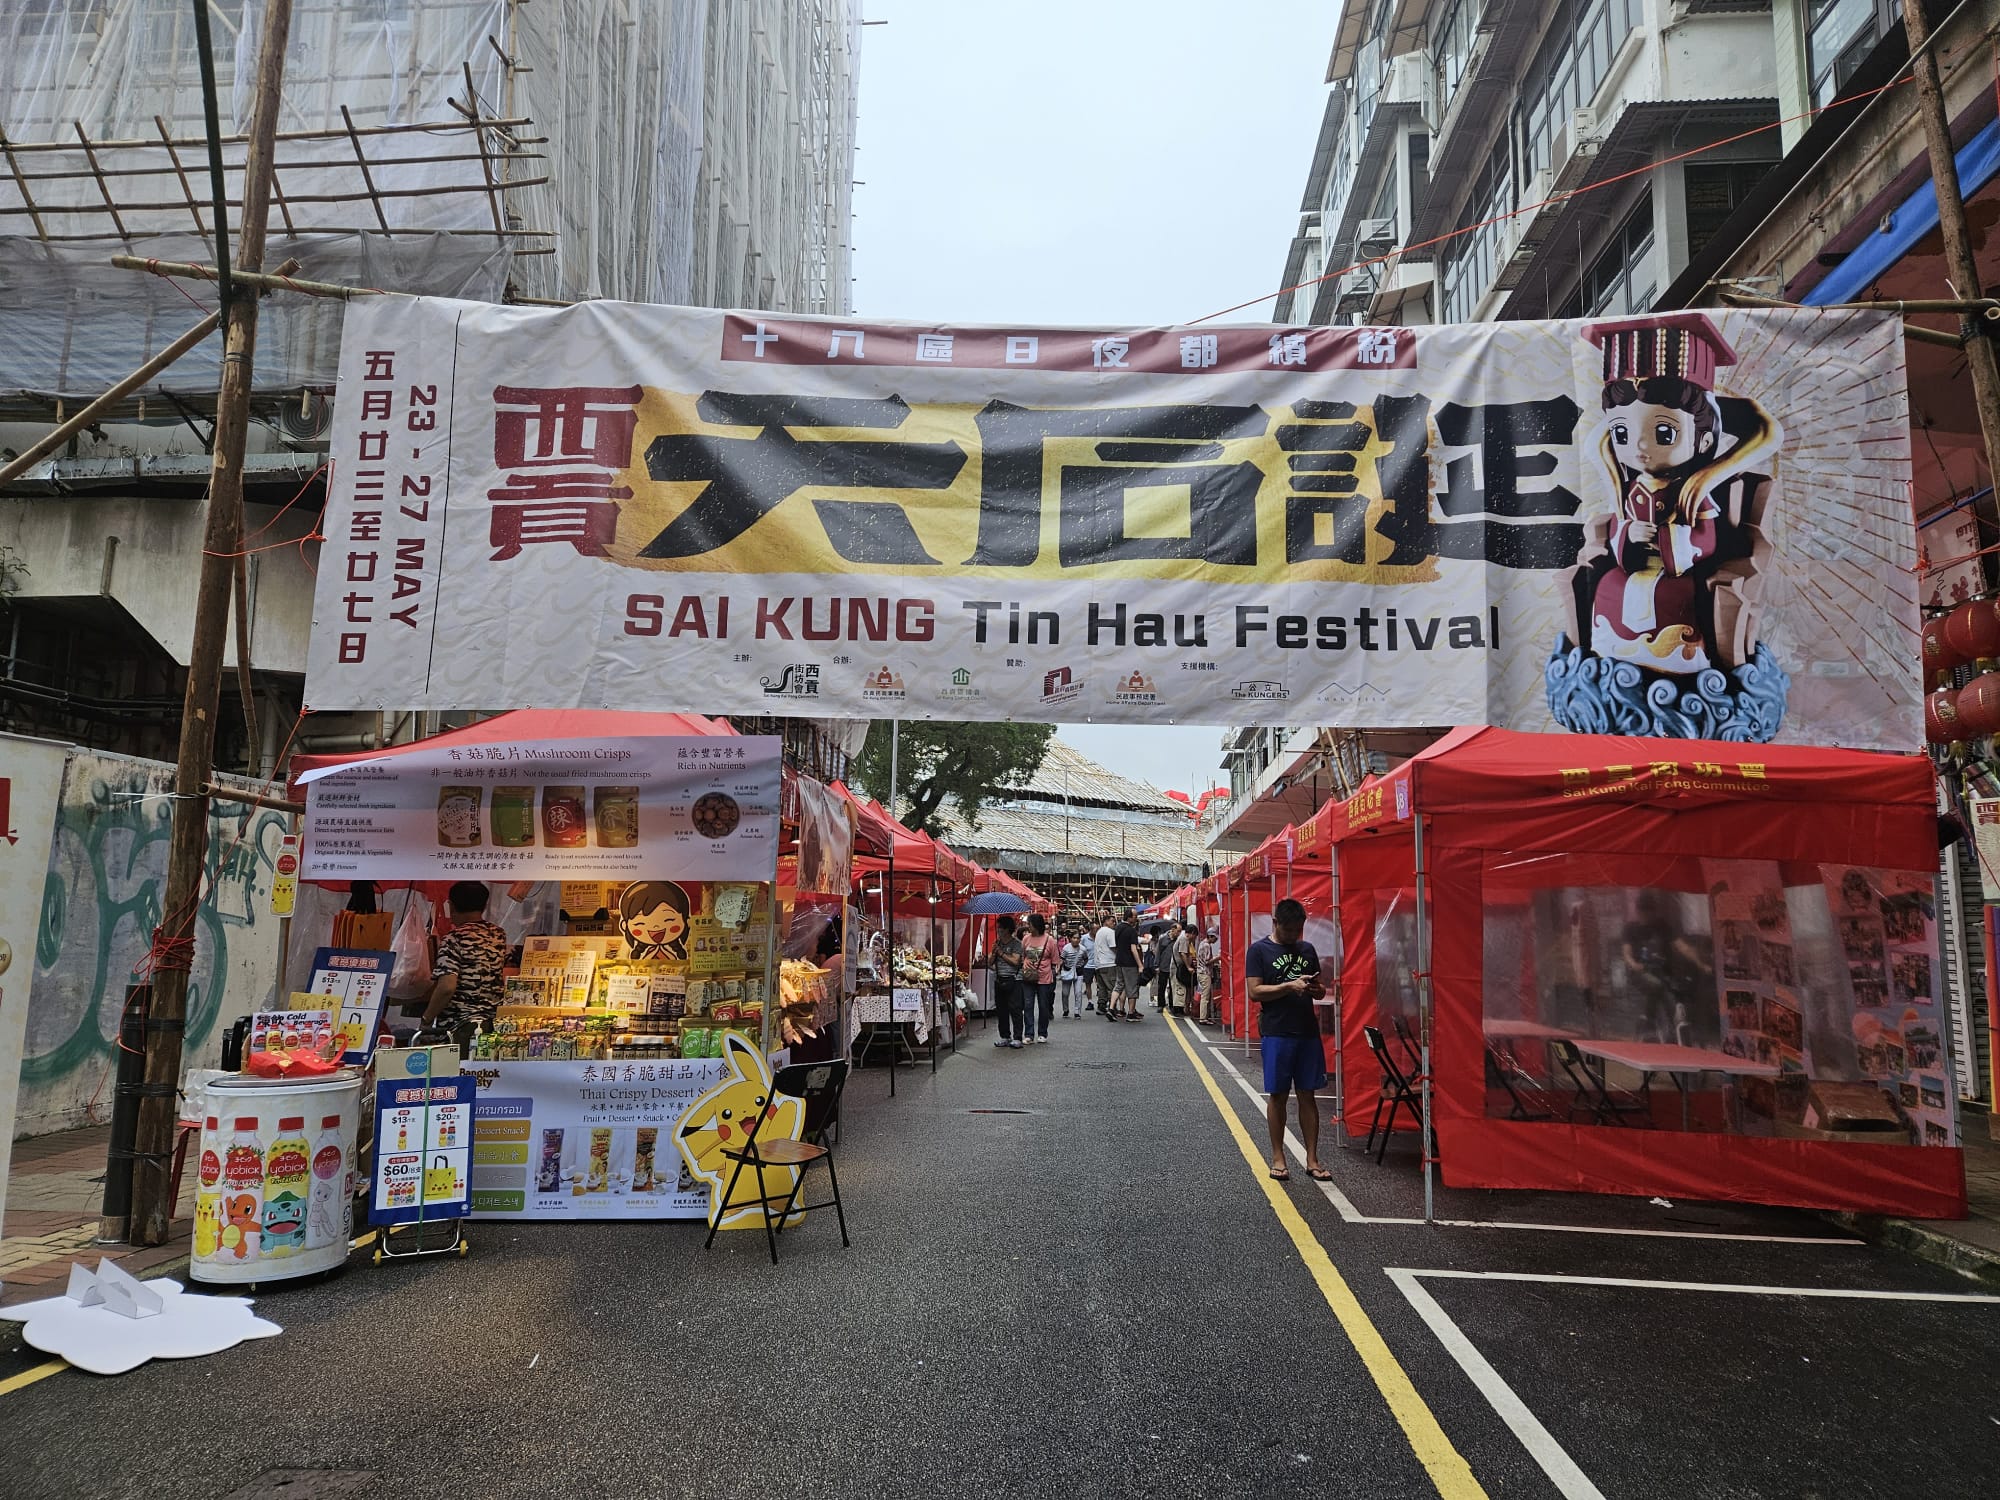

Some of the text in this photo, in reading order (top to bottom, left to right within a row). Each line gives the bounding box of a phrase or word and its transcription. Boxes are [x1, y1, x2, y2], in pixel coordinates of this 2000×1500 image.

[741, 322, 1398, 367] 十八區日夜都繽紛
[407, 384, 437, 432] 23
[487, 383, 644, 562] 西貢
[635, 390, 1584, 570] 天后誕
[338, 350, 396, 664] 五月廿三至廿七日
[399, 475, 430, 522] 27
[390, 537, 424, 629] MAY
[623, 593, 1499, 651] SAI KUNG Tin Hau Festival
[794, 664, 804, 694] 街坊會
[804, 663, 820, 694] 西貢
[448, 747, 631, 761] 香菇脆片 Mushroom Crisps
[571, 769, 588, 777] fried
[589, 769, 628, 777] mushroom
[629, 770, 652, 779] crisps
[678, 762, 746, 770] Rich in Nutrients
[1563, 780, 1770, 798] Sai Kung Kai Fong Committee
[550, 808, 571, 829] 辣
[1272, 954, 1309, 969] SURFNG
[459, 1067, 500, 1080] Bangkok
[583, 1063, 731, 1083] 泰國香脆甜品小食
[580, 1088, 606, 1099] Thai
[609, 1088, 648, 1101] Crispy
[651, 1087, 694, 1099] Dessert
[591, 1103, 607, 1111] 水果
[642, 1103, 659, 1111] 零食
[583, 1115, 600, 1123] Fruit
[642, 1114, 664, 1122] Snack
[475, 1126, 525, 1135] Dessert Snack
[226, 1165, 260, 1177] yobick
[270, 1162, 305, 1175] yobick
[478, 1197, 519, 1206] 디저트 스낵
